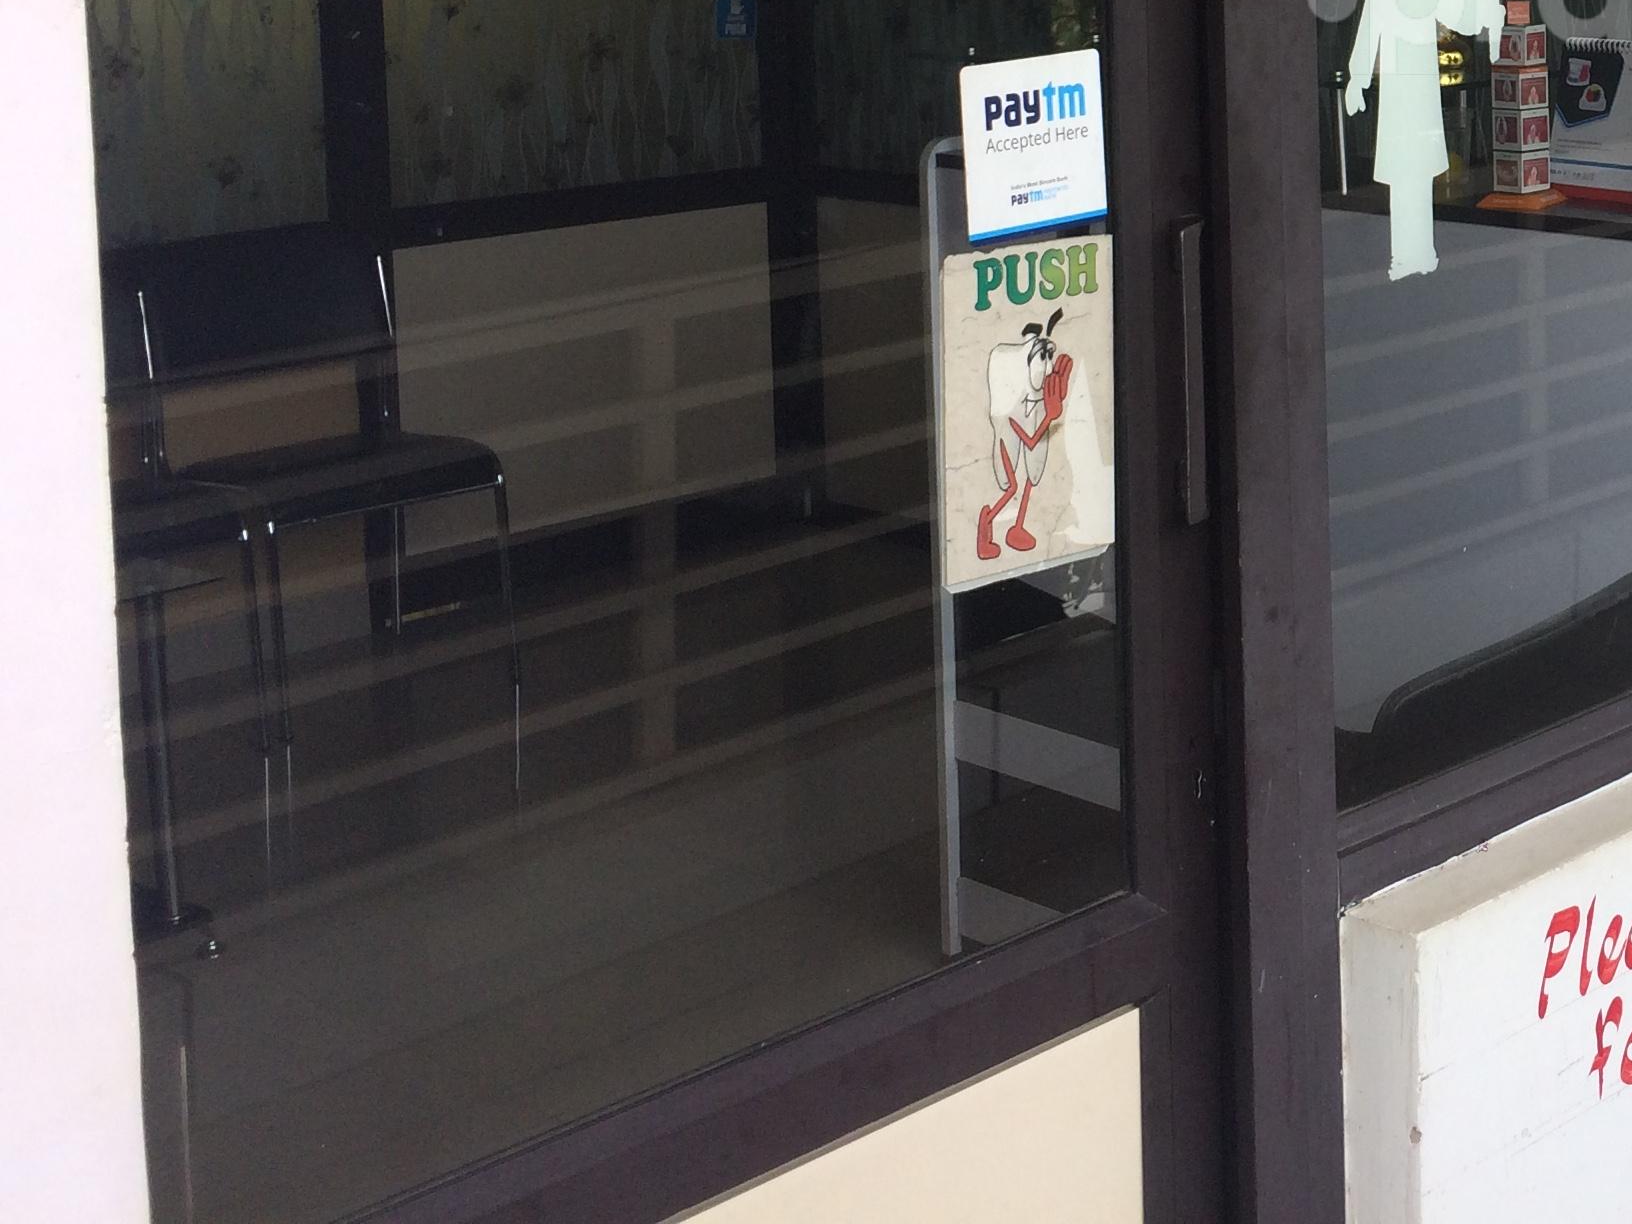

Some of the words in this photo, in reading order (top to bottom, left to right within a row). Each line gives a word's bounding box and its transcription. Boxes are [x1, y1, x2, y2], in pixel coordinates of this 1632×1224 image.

[985, 129, 1052, 155] Accepted
[1055, 125, 1090, 144] Here
[973, 243, 1099, 311] PUSH
